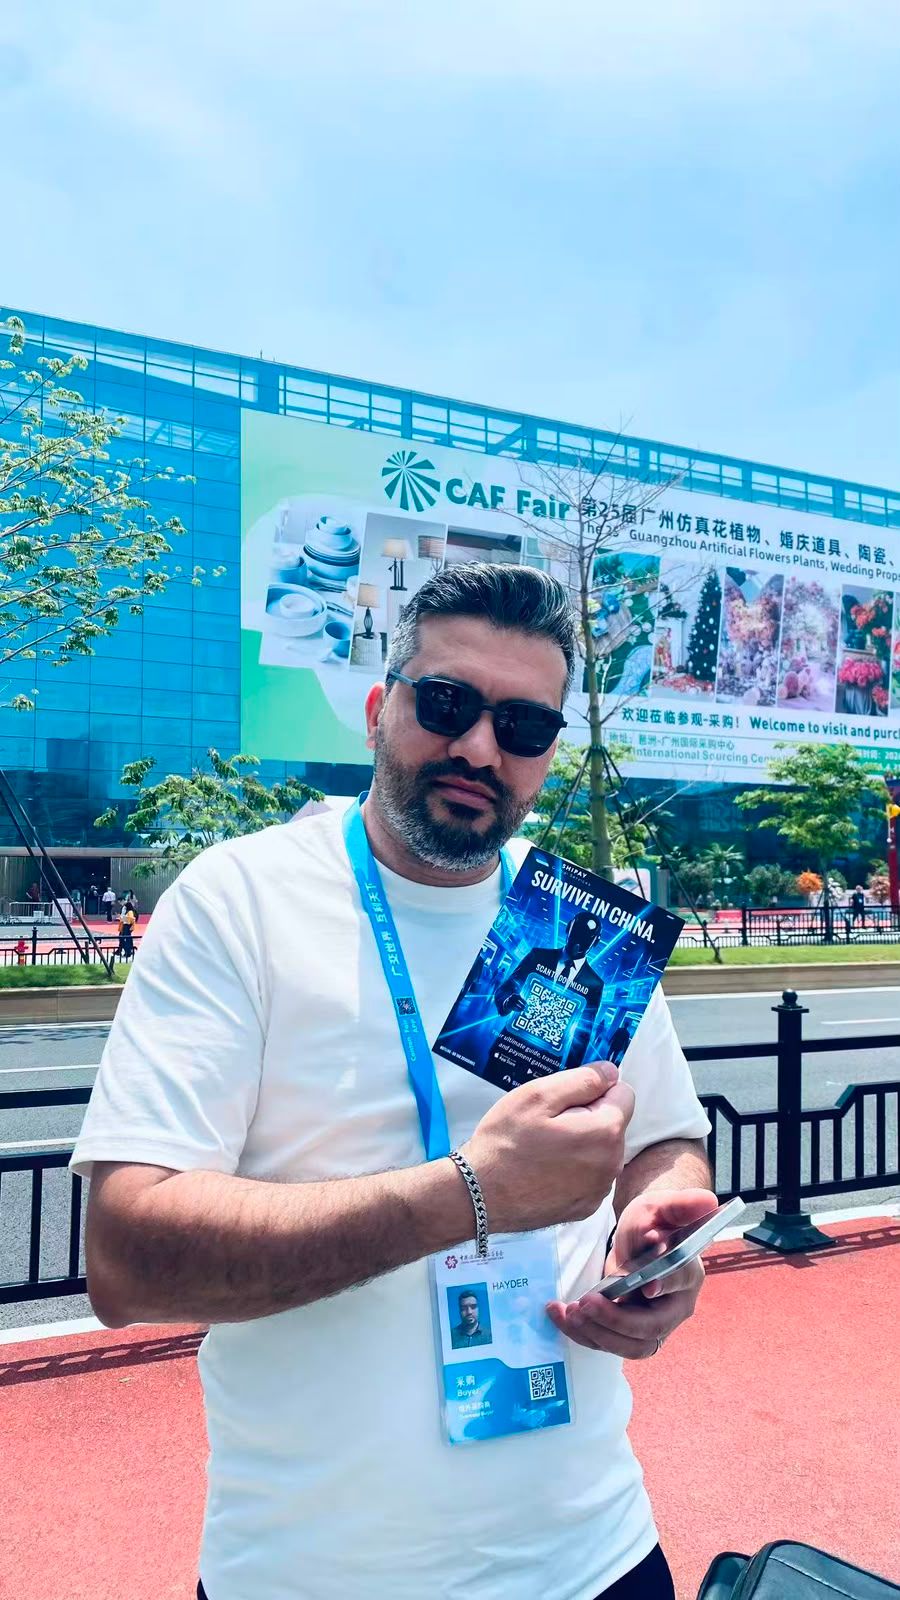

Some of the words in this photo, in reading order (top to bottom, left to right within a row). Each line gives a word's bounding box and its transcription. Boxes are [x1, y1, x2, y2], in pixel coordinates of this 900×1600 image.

[446, 478, 505, 509] CAF
[516, 490, 570, 520] Fair
[629, 529, 697, 550] Guangzhou
[699, 540, 747, 558] Artificial
[749, 547, 791, 564] Flowers
[793, 555, 828, 571] Plants,
[830, 561, 874, 579] Wedding
[749, 716, 805, 732] Welcome
[808, 721, 820, 734] to
[822, 722, 848, 736] visit
[850, 726, 871, 738] and
[873, 728, 900, 741] purc
[633, 748, 700, 760] International
[702, 750, 748, 764] Sourcing
[562, 863, 588, 879] SHIPAY
[365, 883, 388, 924] 互利天下
[531, 870, 594, 911] SURVIVE
[590, 896, 611, 919] IN
[608, 906, 656, 944] CHINA.
[381, 931, 403, 977] 广交世界
[535, 963, 552, 977] SCAN
[557, 974, 589, 995] DONLOAD
[498, 1043, 509, 1051] and
[508, 1048, 532, 1063] payment
[503, 1035, 526, 1050] ultimate
[524, 1046, 541, 1059] guide,
[492, 1277, 529, 1291] HAYDER
[456, 1375, 476, 1387] 采购
[457, 1387, 481, 1398] Buyer
